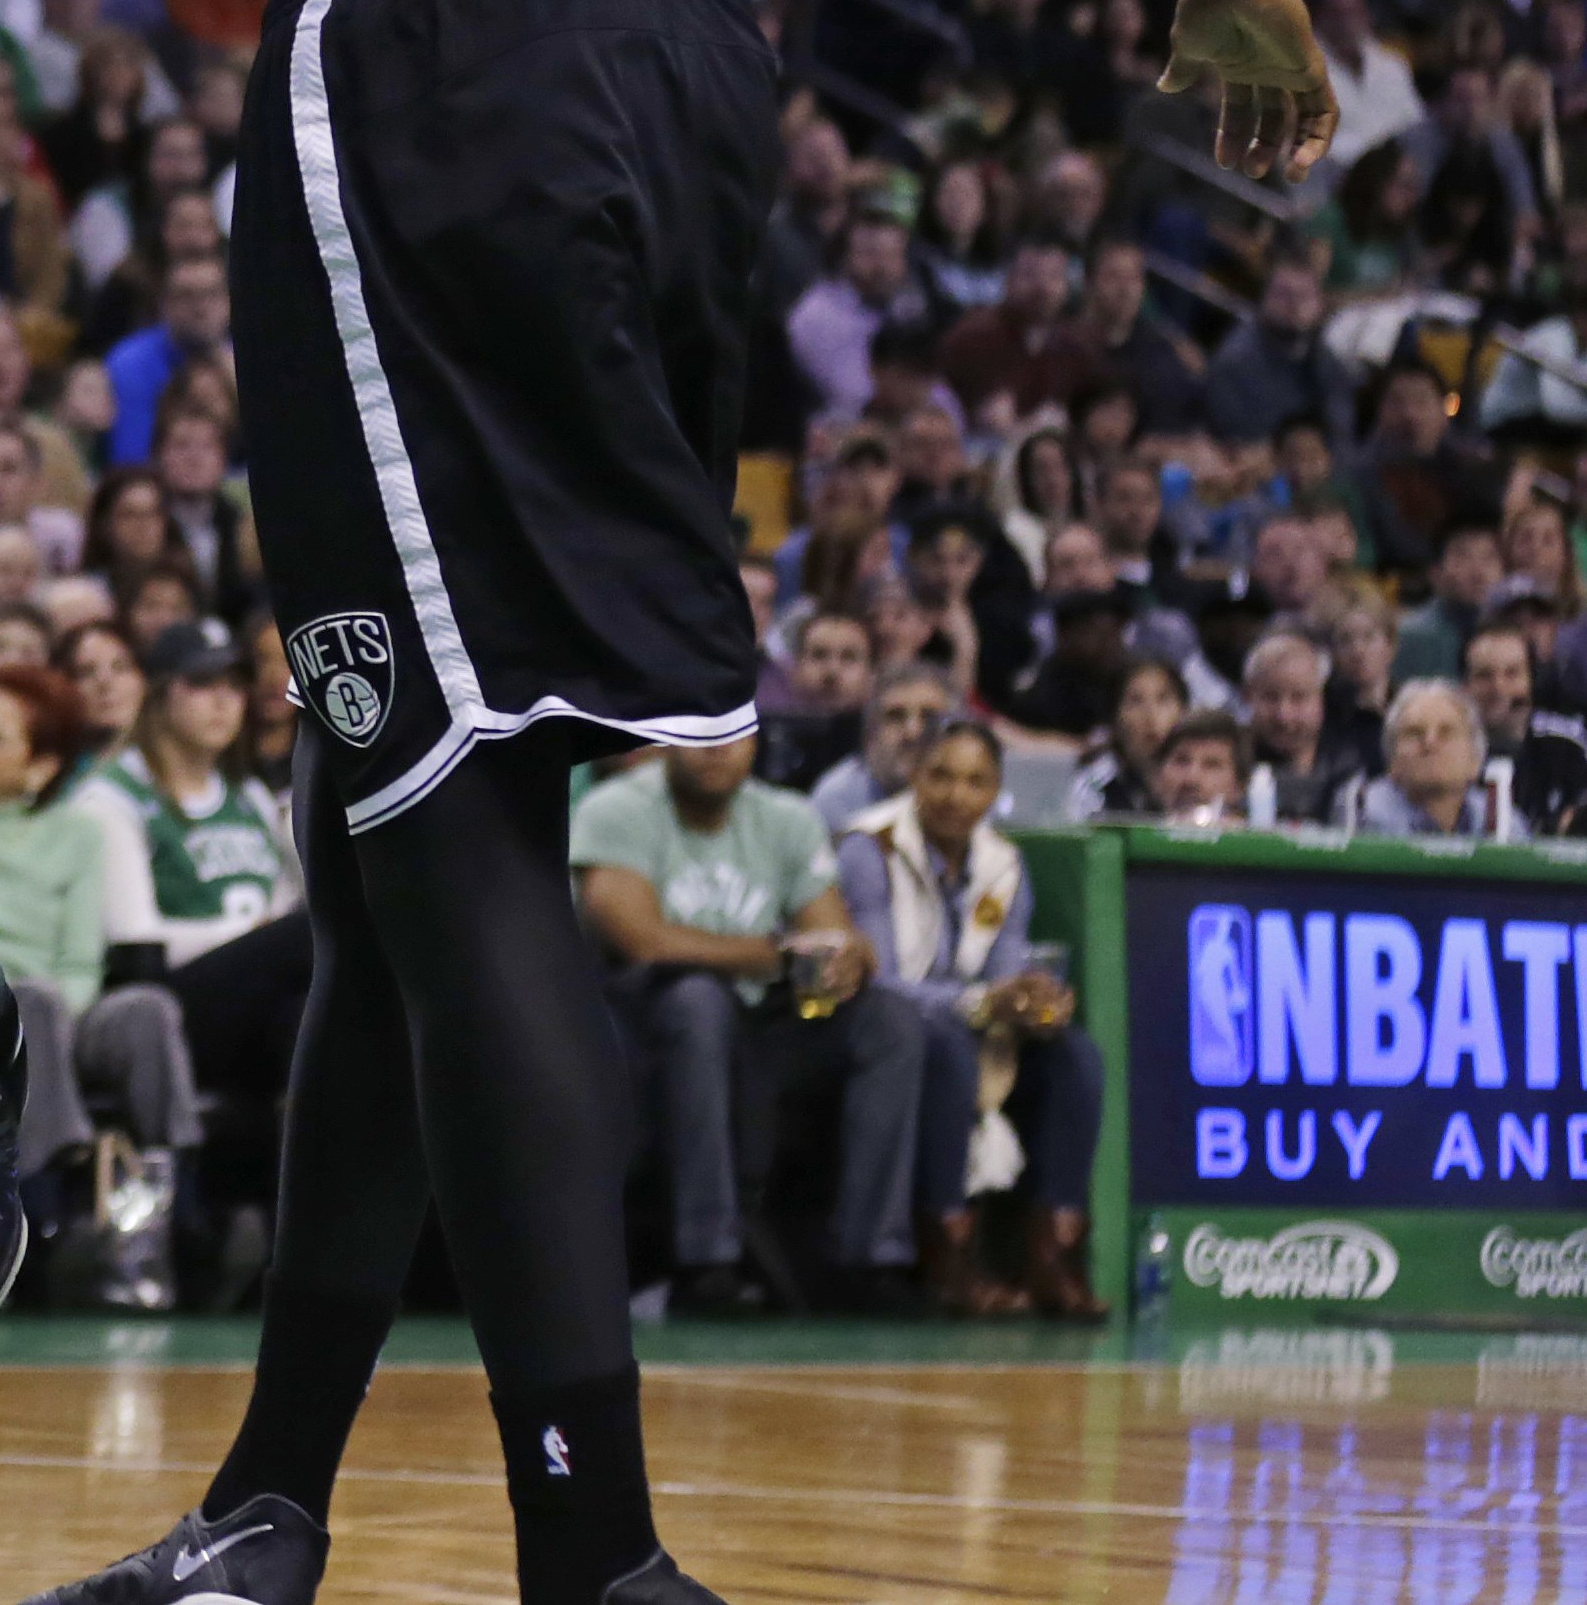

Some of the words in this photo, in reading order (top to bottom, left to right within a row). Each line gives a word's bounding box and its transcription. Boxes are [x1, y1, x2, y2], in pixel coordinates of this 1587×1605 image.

[292, 618, 388, 687] NETS
[338, 681, 365, 728] B
[1255, 909, 1587, 1090] NBAT
[1195, 1106, 1383, 1181] BUY
